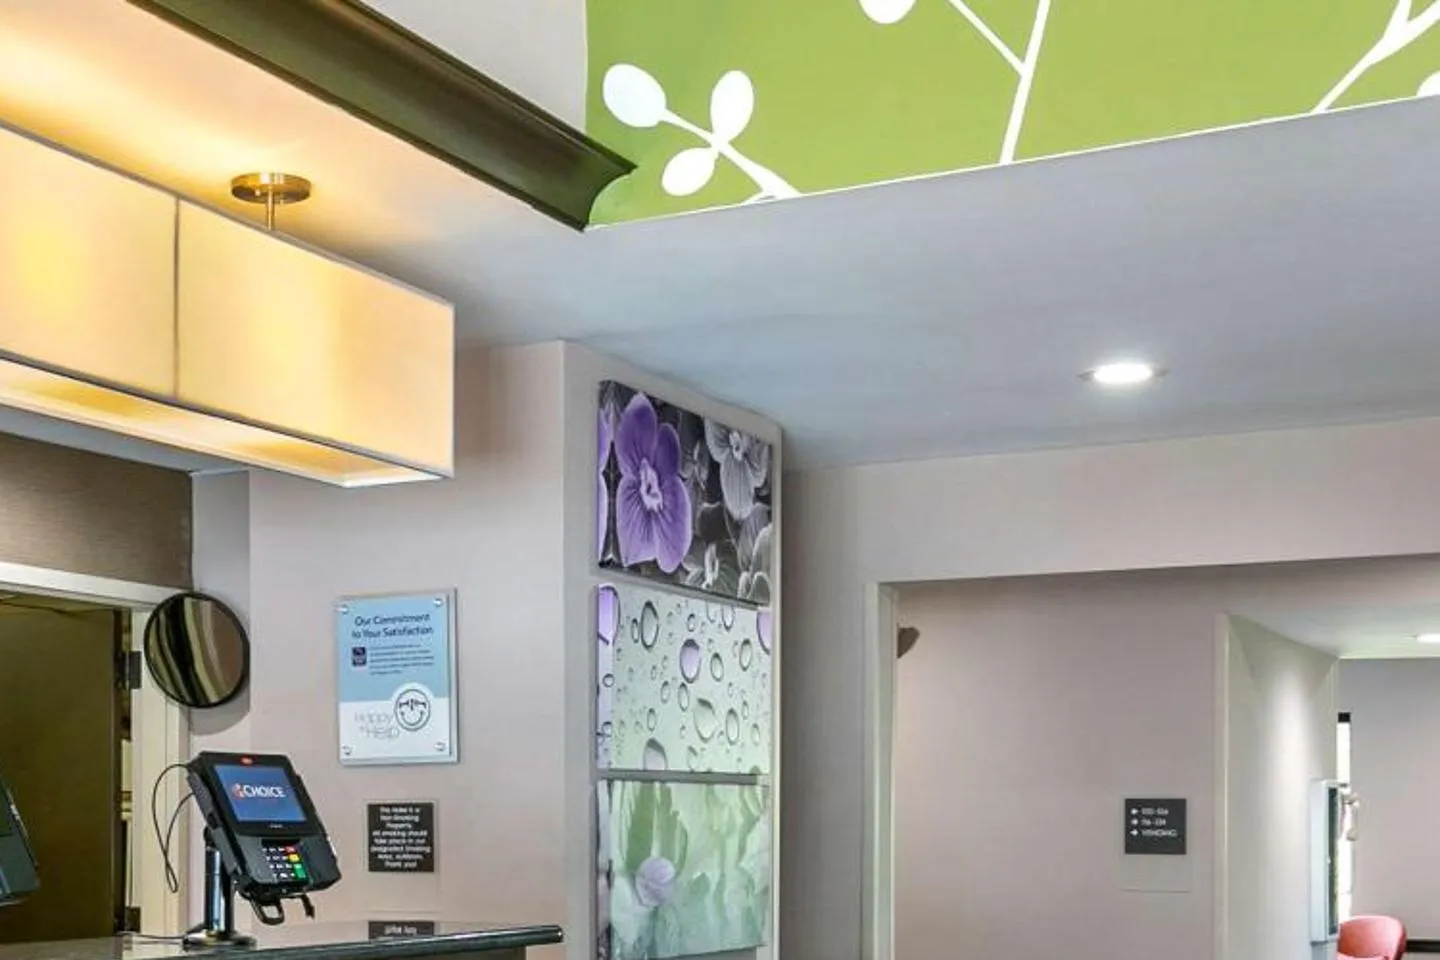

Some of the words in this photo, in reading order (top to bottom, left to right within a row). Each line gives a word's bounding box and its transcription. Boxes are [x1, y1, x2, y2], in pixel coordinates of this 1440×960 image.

[354, 615, 371, 627] Our
[373, 613, 430, 625] Commitment
[352, 629, 362, 638] to
[362, 628, 381, 638] Your
[383, 626, 434, 637] Satisfaction
[242, 784, 287, 798] CHOICE
